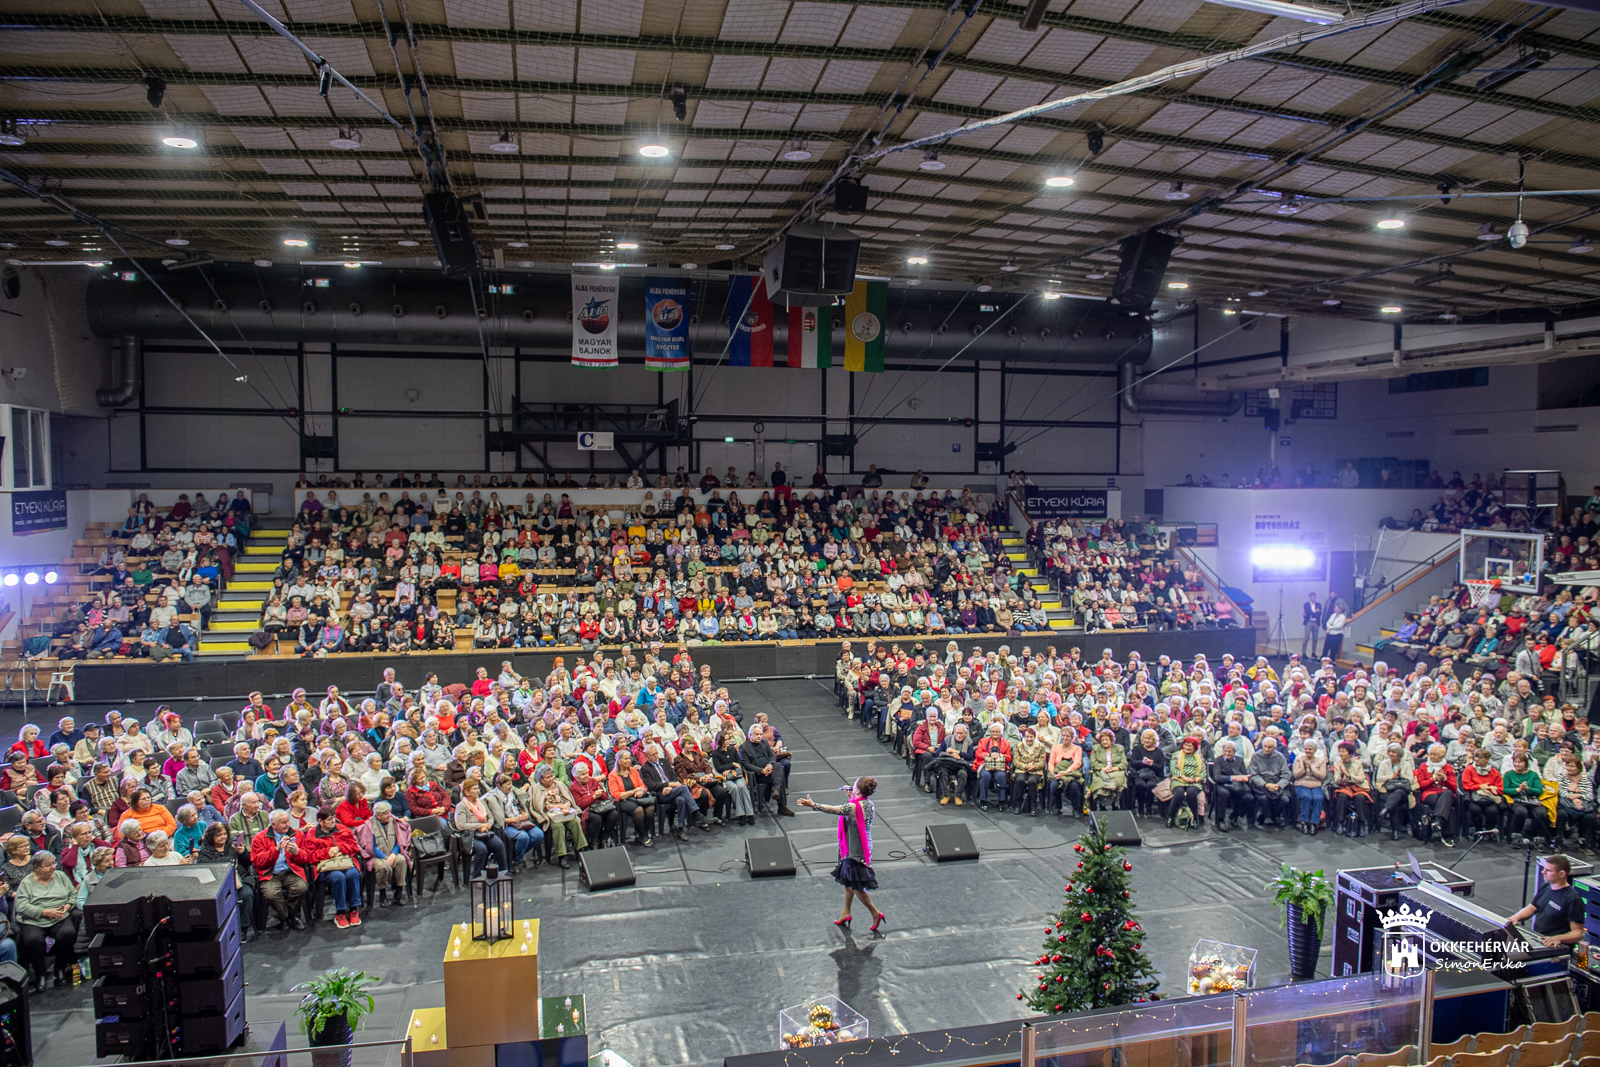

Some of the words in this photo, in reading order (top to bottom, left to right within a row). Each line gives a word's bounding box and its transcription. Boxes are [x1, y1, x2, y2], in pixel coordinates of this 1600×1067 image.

[577, 306, 608, 320] ALBA
[579, 433, 594, 447] C
[15, 502, 42, 514] ETYEKI
[43, 498, 65, 512] KÚRIA
[1028, 497, 1068, 506] ETYEKI
[1071, 495, 1105, 506] KÚRIA
[1255, 520, 1300, 529] BÚTORHÁZ
